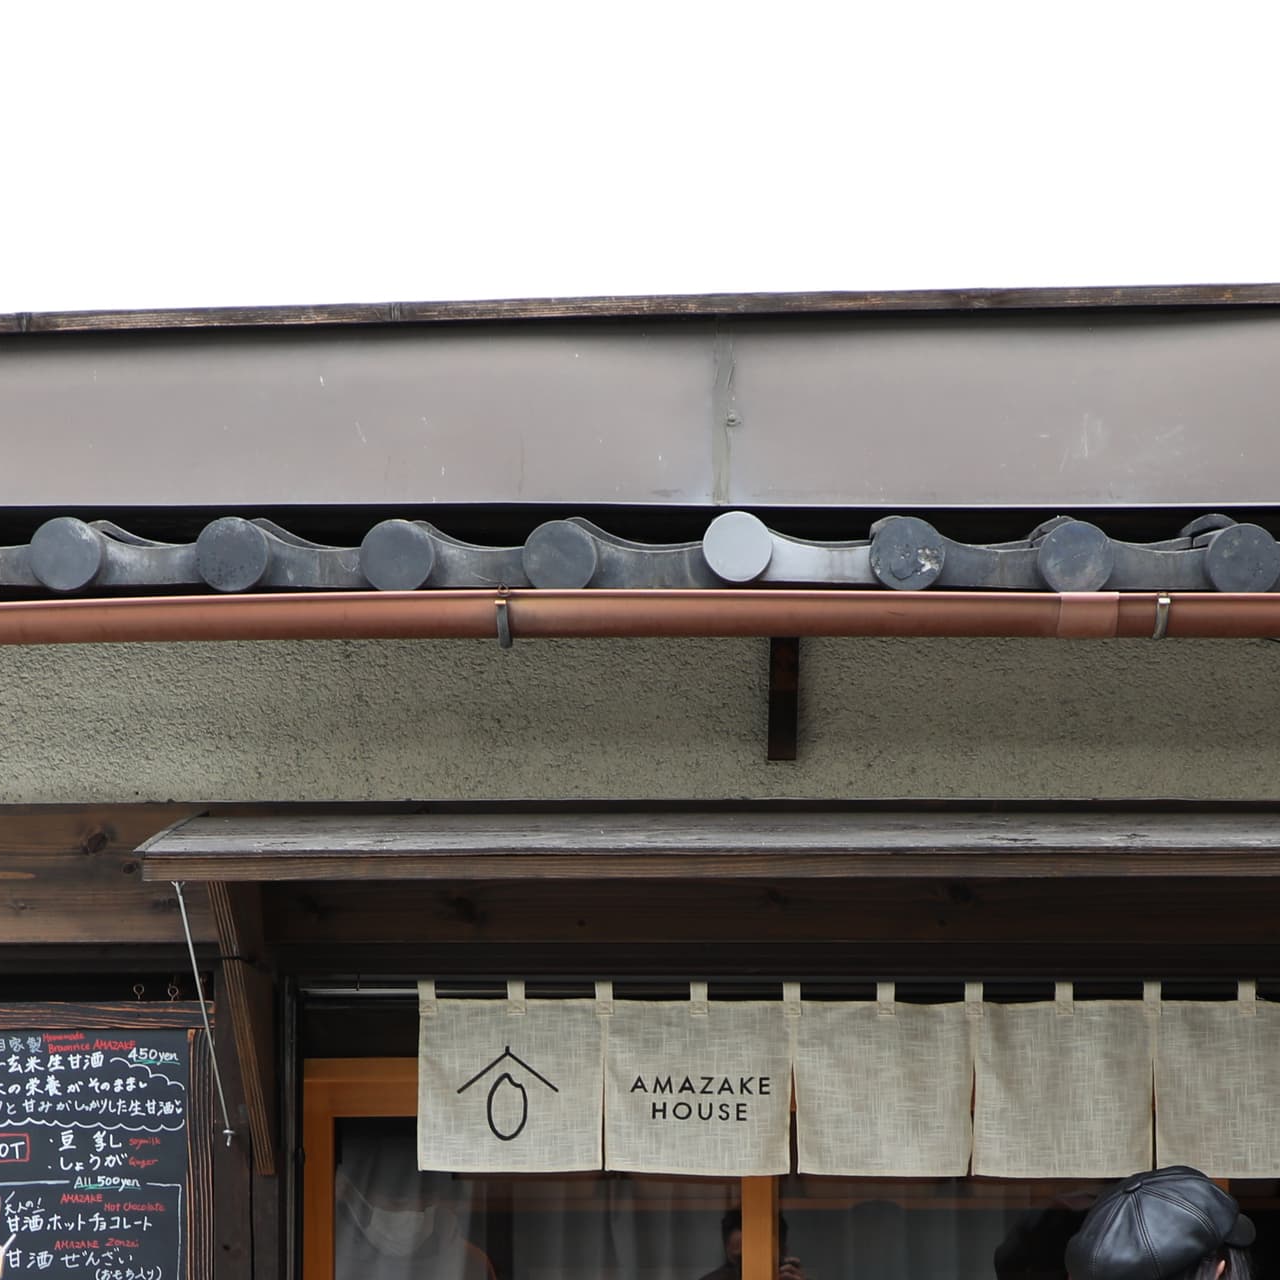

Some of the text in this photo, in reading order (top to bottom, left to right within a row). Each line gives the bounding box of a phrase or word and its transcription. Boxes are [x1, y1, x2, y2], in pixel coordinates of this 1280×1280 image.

[93, 1040, 137, 1051] AMAZAKE
[6, 1051, 105, 1073] 玄米生甘酒
[128, 1047, 180, 1063] 450yen
[630, 1075, 772, 1096] AMAZAKE
[651, 1102, 748, 1122] HOUSE
[74, 1175, 140, 1192] All 500yen
[60, 1193, 103, 1205] AMAZAKE
[6, 1212, 153, 1233] 甘酒ホットチョコレート
[54, 1239, 100, 1250] AMAZAKE
[5, 1247, 133, 1269] 甘酒ぜんざい
